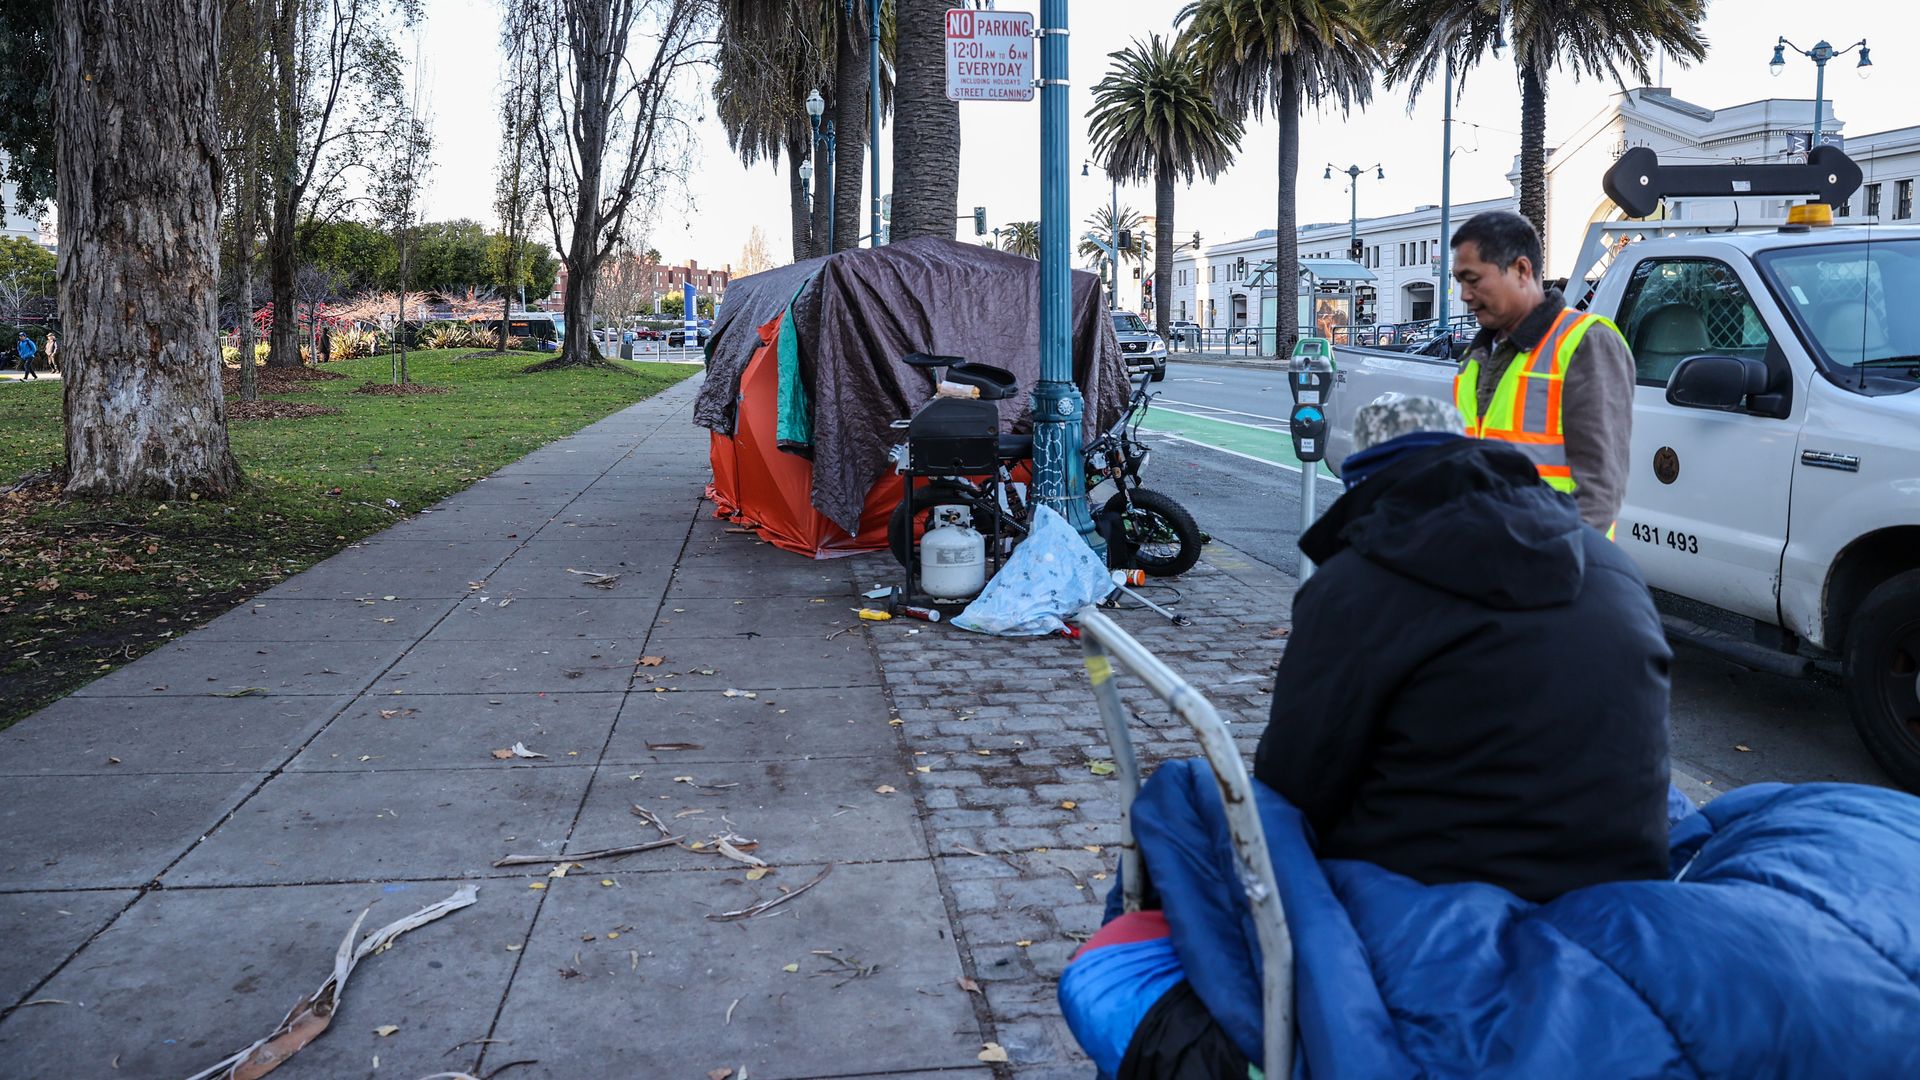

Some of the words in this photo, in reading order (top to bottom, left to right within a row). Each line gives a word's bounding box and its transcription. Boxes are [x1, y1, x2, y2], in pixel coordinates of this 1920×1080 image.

[949, 13, 971, 36] NO
[977, 19, 1029, 37] PARKING
[953, 42, 983, 58] 12:01
[958, 62, 1022, 76] EVERYDAY
[954, 87, 984, 97] STREET
[988, 88, 1027, 98] CLEANING
[1632, 522, 1660, 545] 431
[1666, 530, 1699, 554] 493
